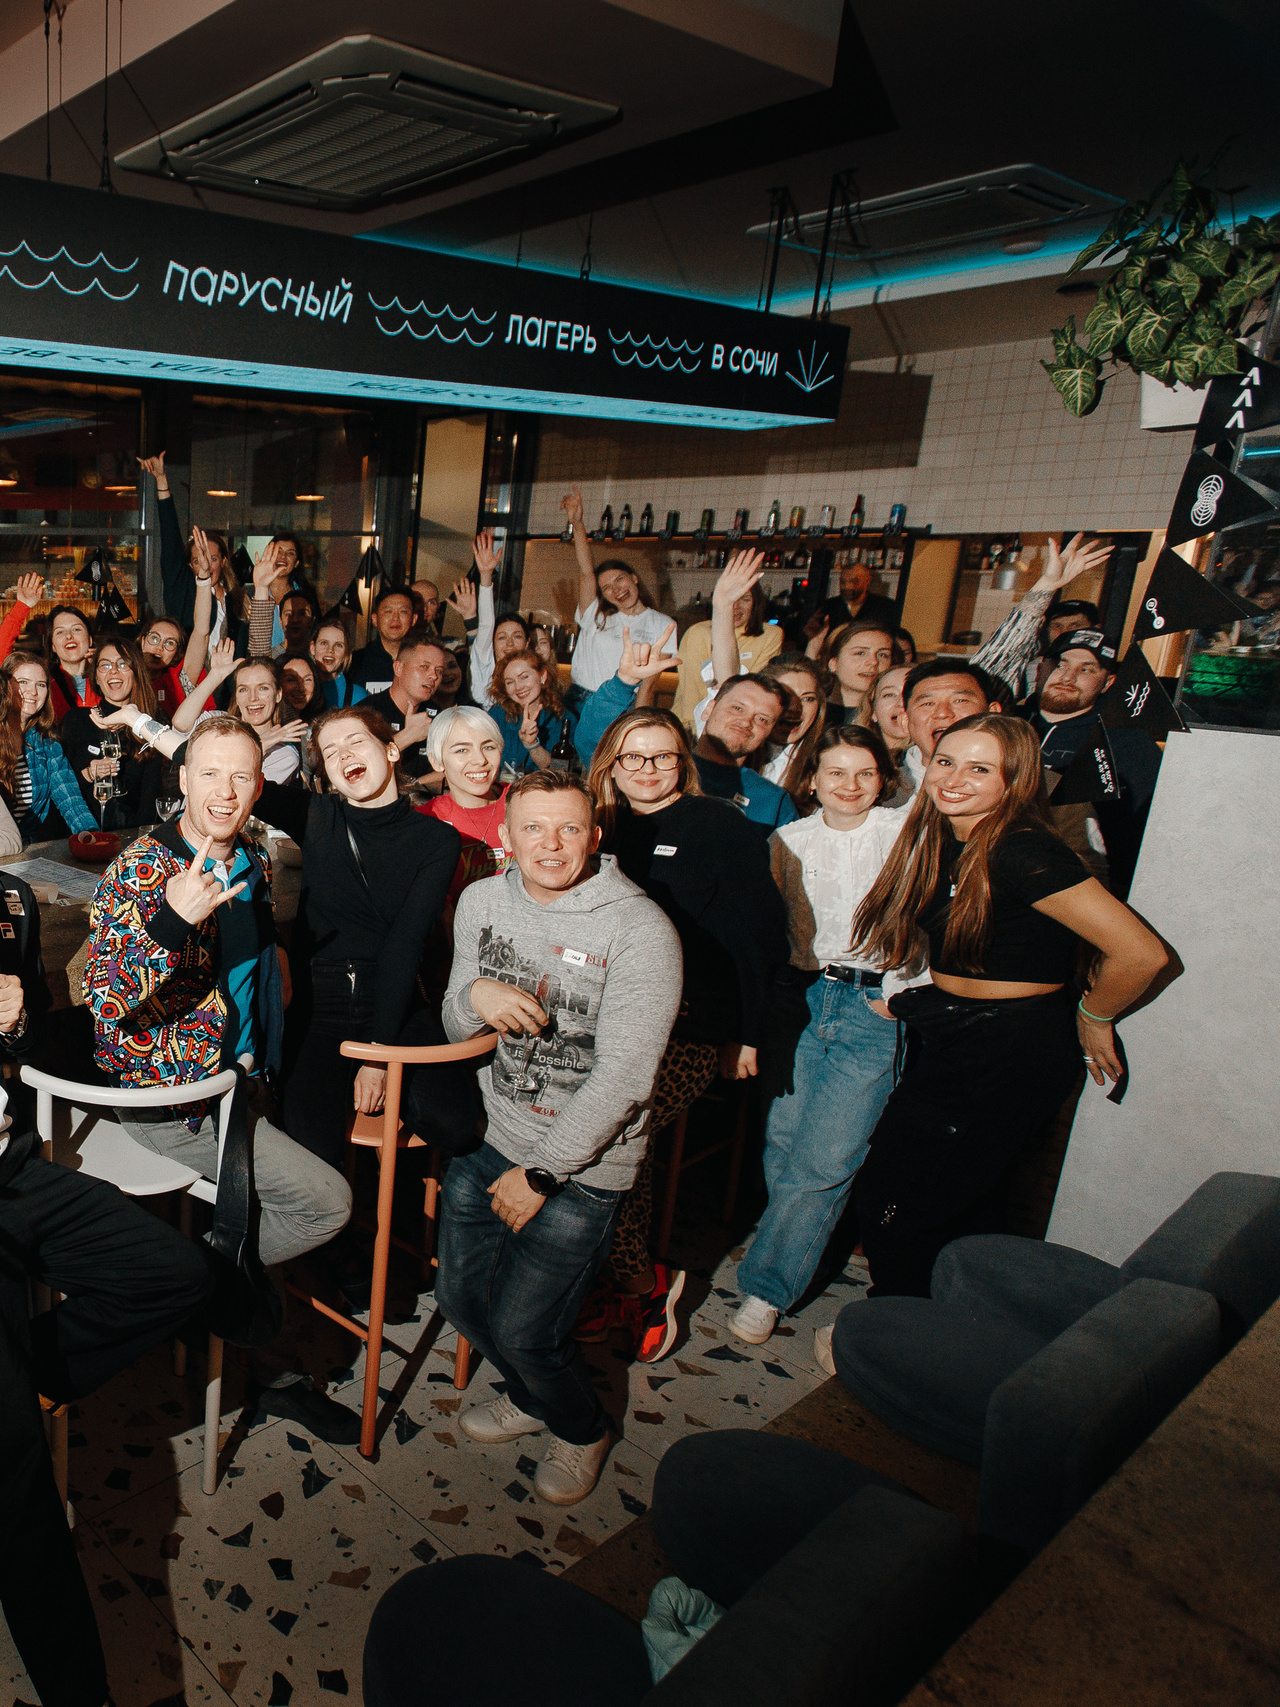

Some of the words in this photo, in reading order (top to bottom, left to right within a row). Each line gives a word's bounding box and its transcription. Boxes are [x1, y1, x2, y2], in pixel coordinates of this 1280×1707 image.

[150, 360, 260, 377] СИЛА
[711, 343, 725, 370] В
[728, 345, 779, 377] СОЧИ
